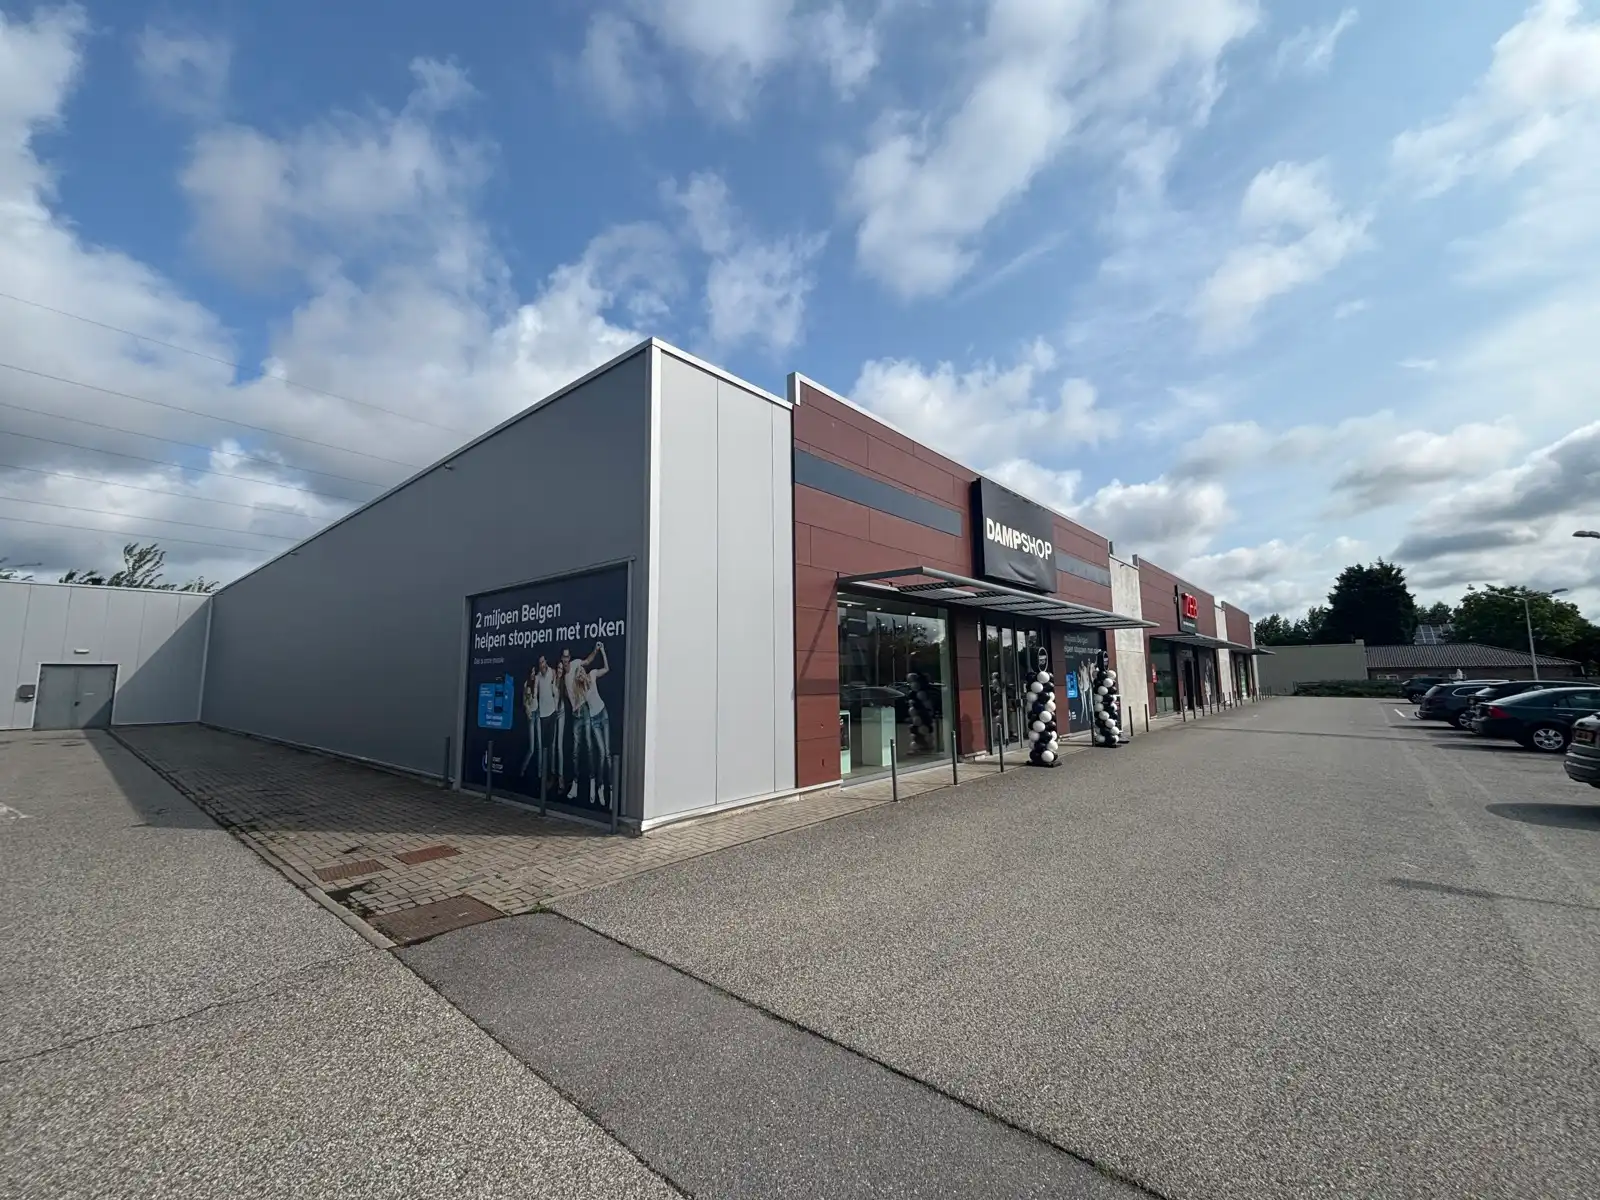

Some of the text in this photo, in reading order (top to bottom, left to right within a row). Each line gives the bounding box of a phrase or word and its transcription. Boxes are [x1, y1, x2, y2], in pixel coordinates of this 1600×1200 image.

[986, 517, 1052, 560] DAMPSHOP
[475, 602, 561, 630] 2 miljoen Belgen
[474, 617, 625, 652] helpen stoppen met roken
